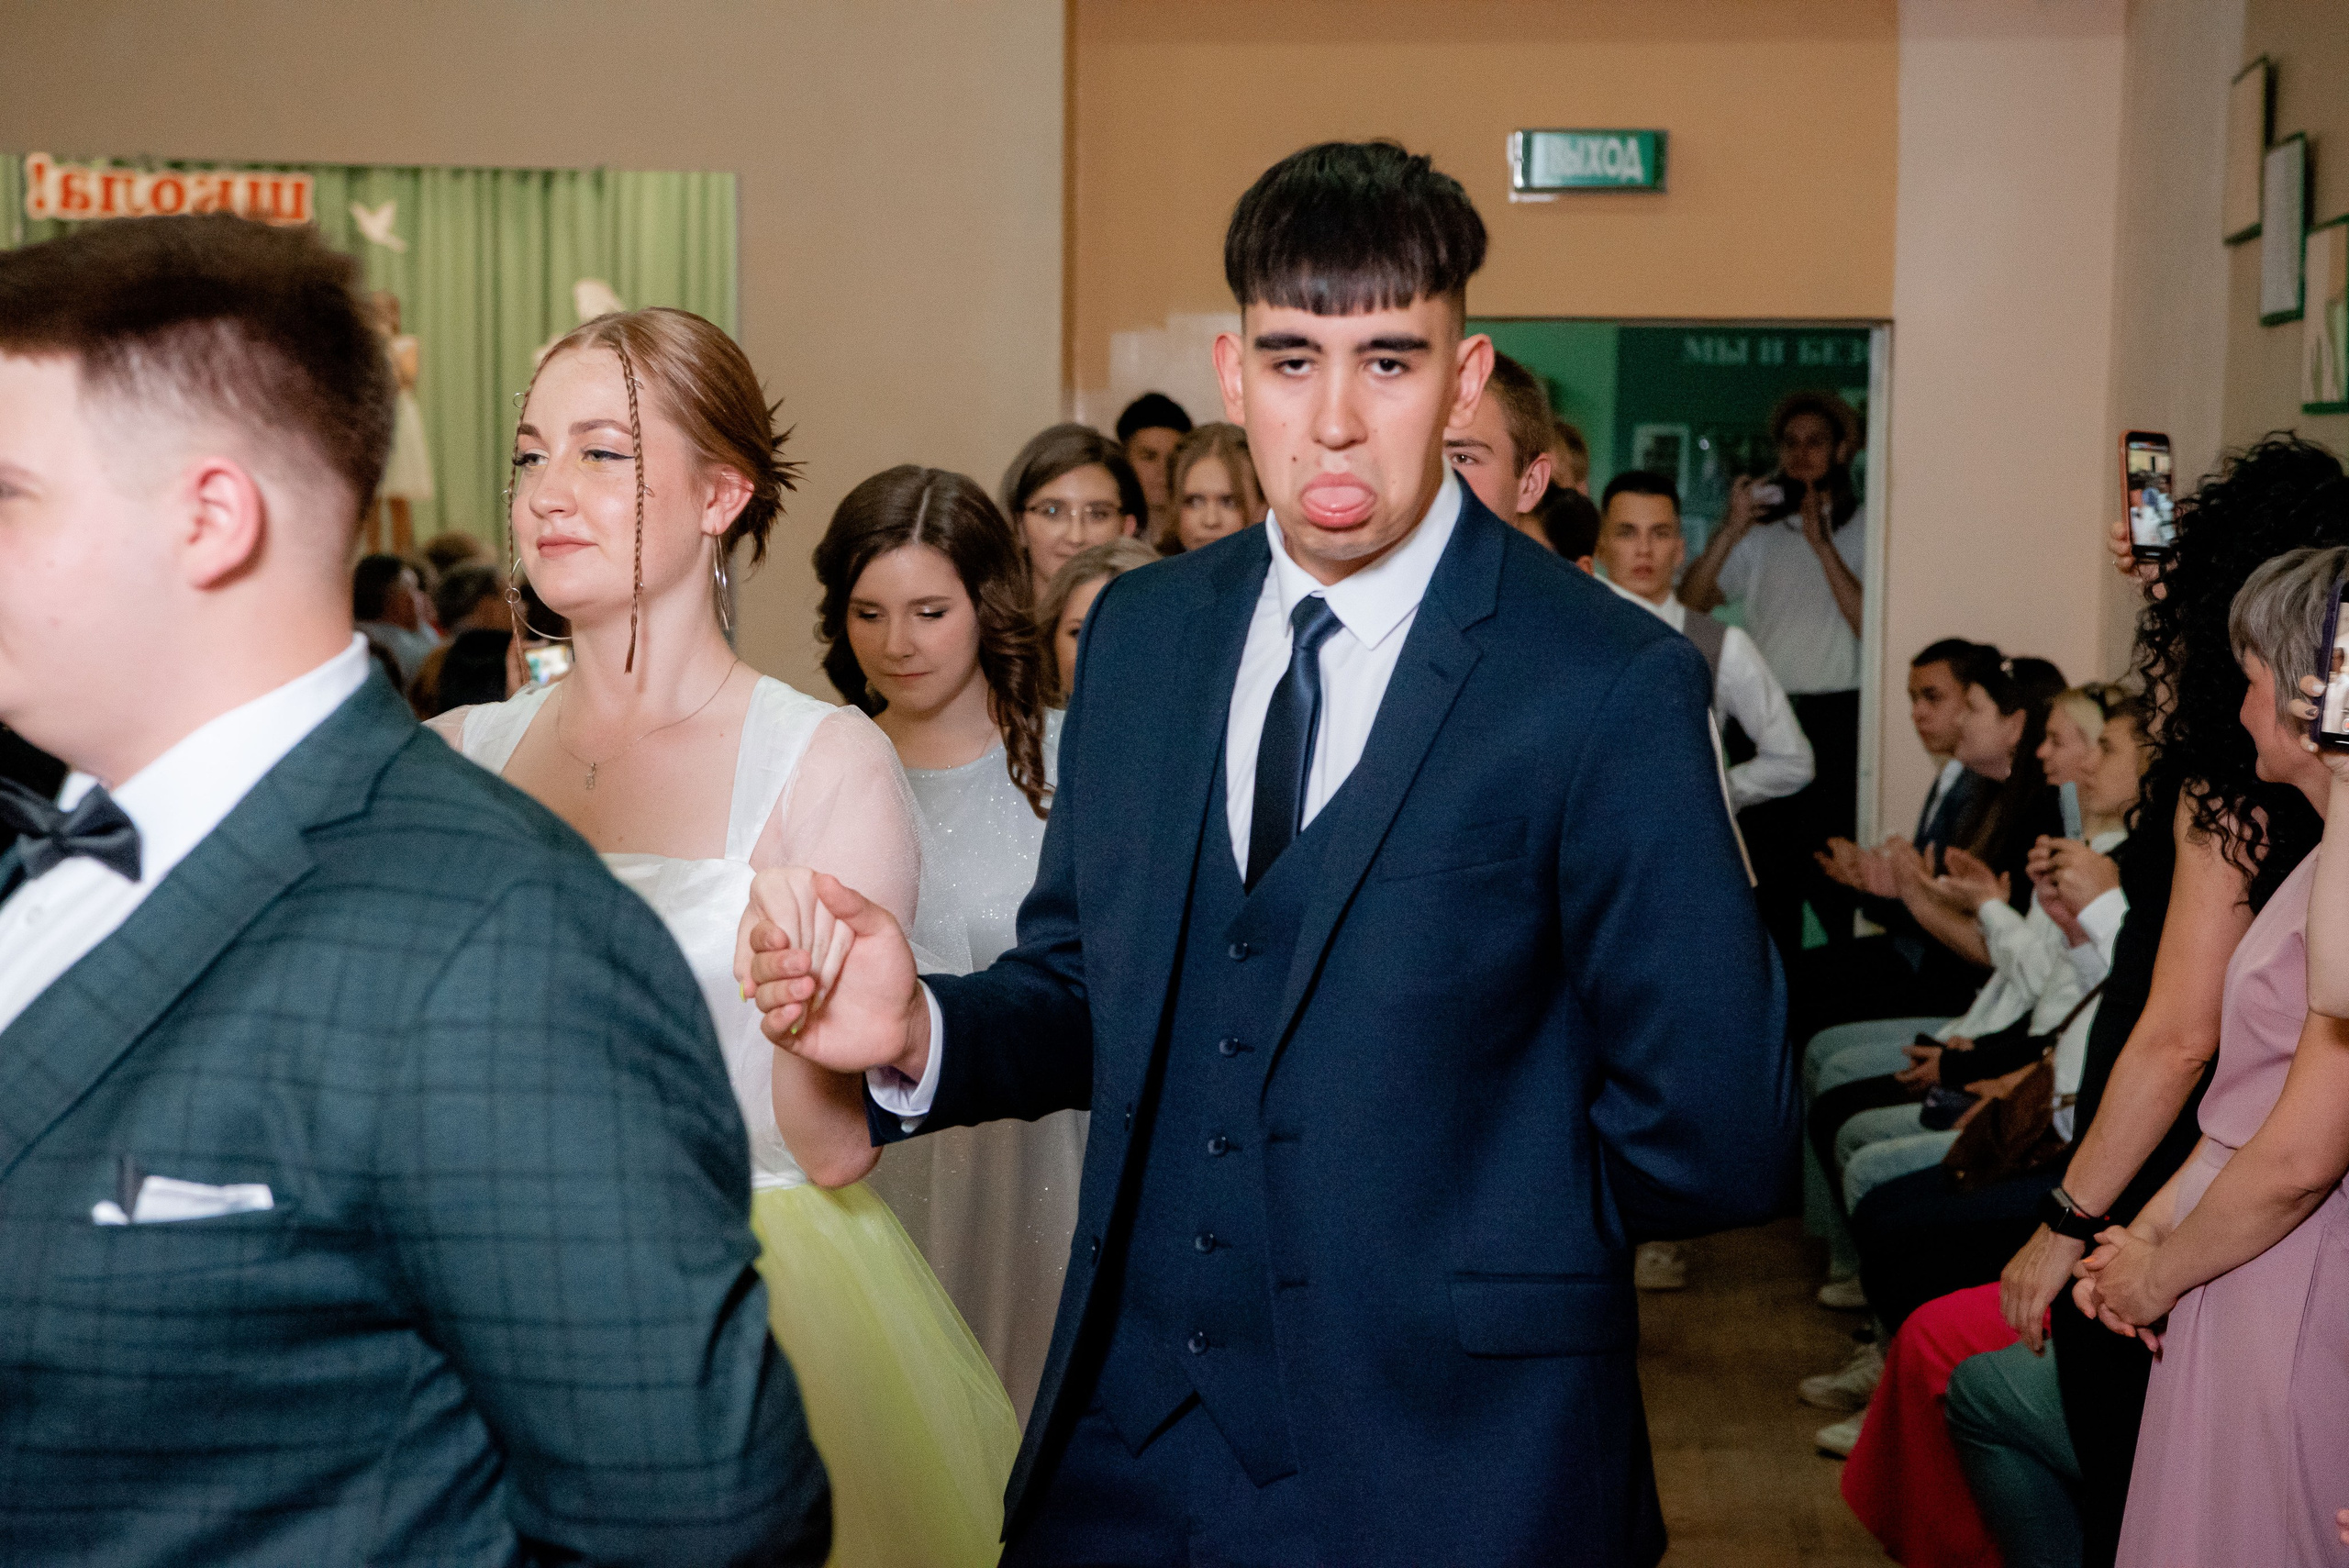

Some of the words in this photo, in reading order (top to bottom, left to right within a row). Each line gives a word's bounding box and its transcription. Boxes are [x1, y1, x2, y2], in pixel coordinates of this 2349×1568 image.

[1546, 137, 1644, 183] ВЫХОД
[1685, 337, 1748, 364] МЫ
[1798, 337, 1868, 365] БЕЗ
